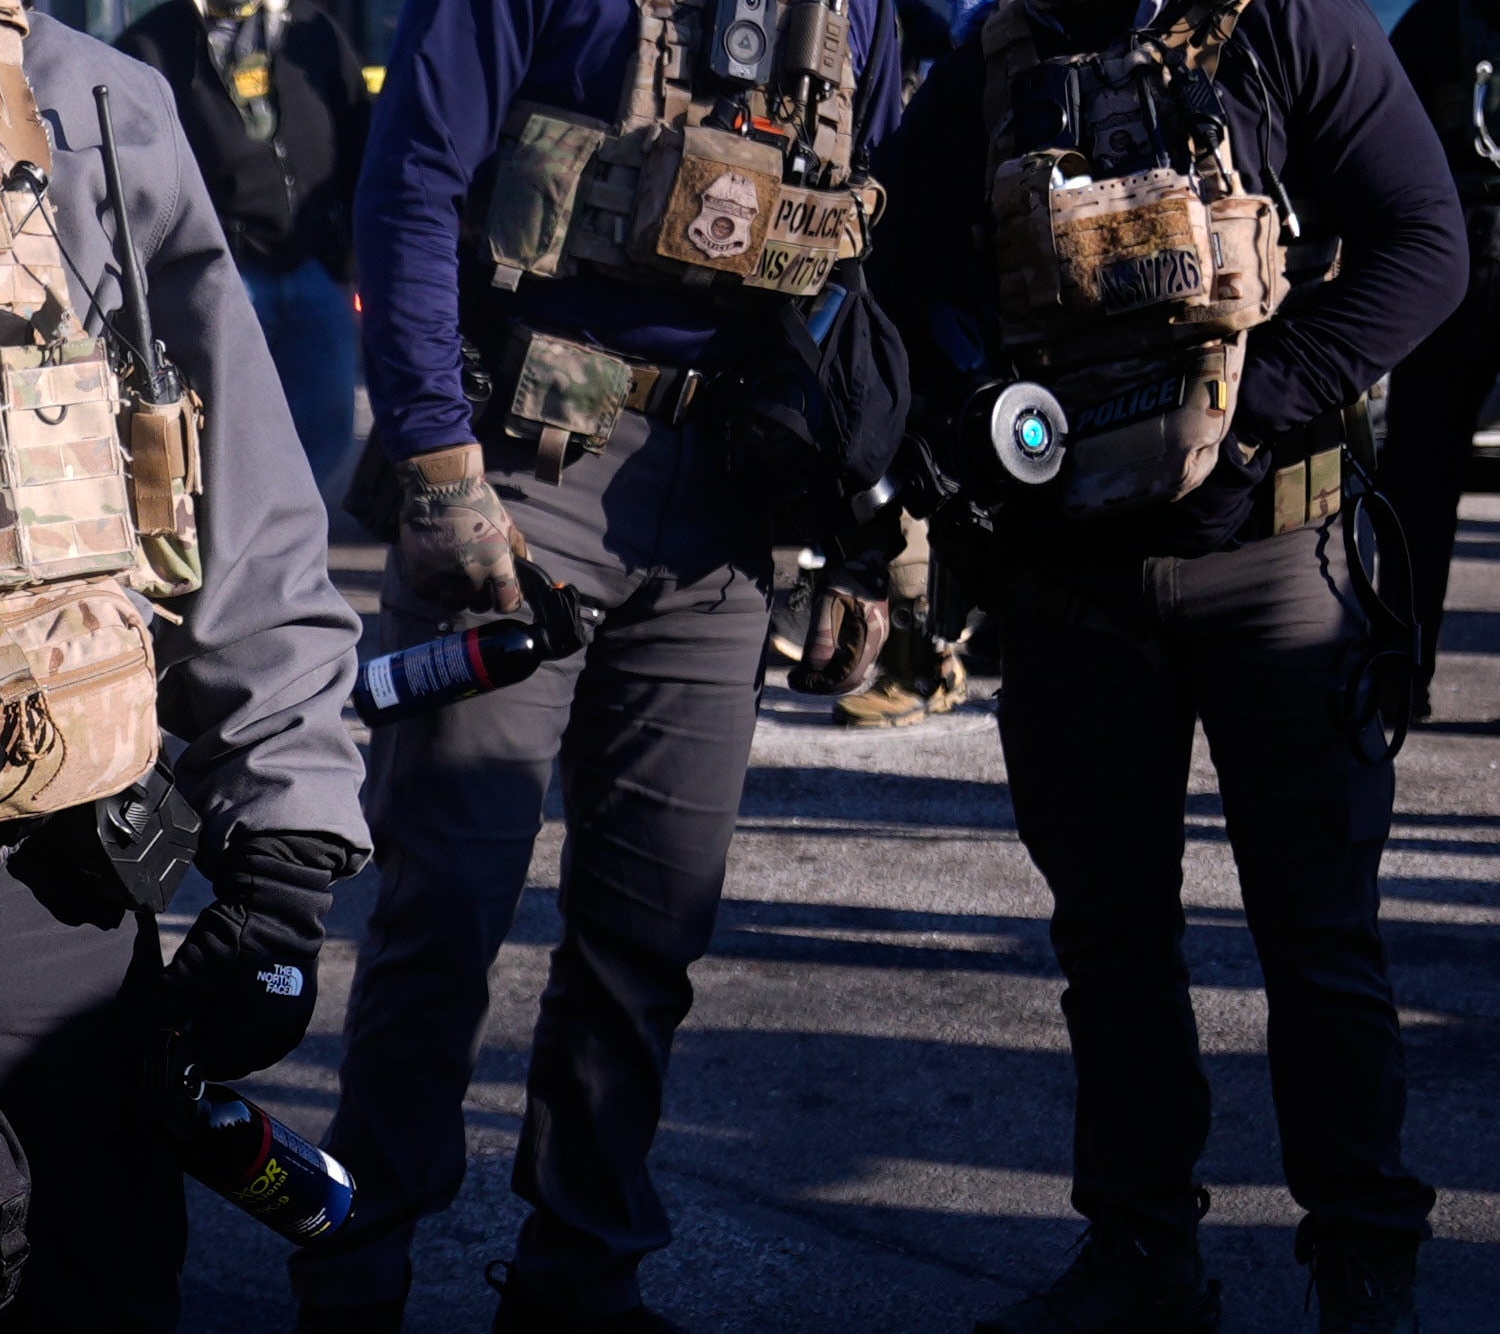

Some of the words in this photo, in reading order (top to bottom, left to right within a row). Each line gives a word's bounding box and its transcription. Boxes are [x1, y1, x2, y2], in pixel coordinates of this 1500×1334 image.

[774, 199, 848, 239] POLICE
[753, 248, 788, 280] NS
[1076, 373, 1179, 435] POLICE
[256, 970, 291, 986] NORTH
[273, 963, 292, 976] THE
[265, 982, 291, 996] FACE
